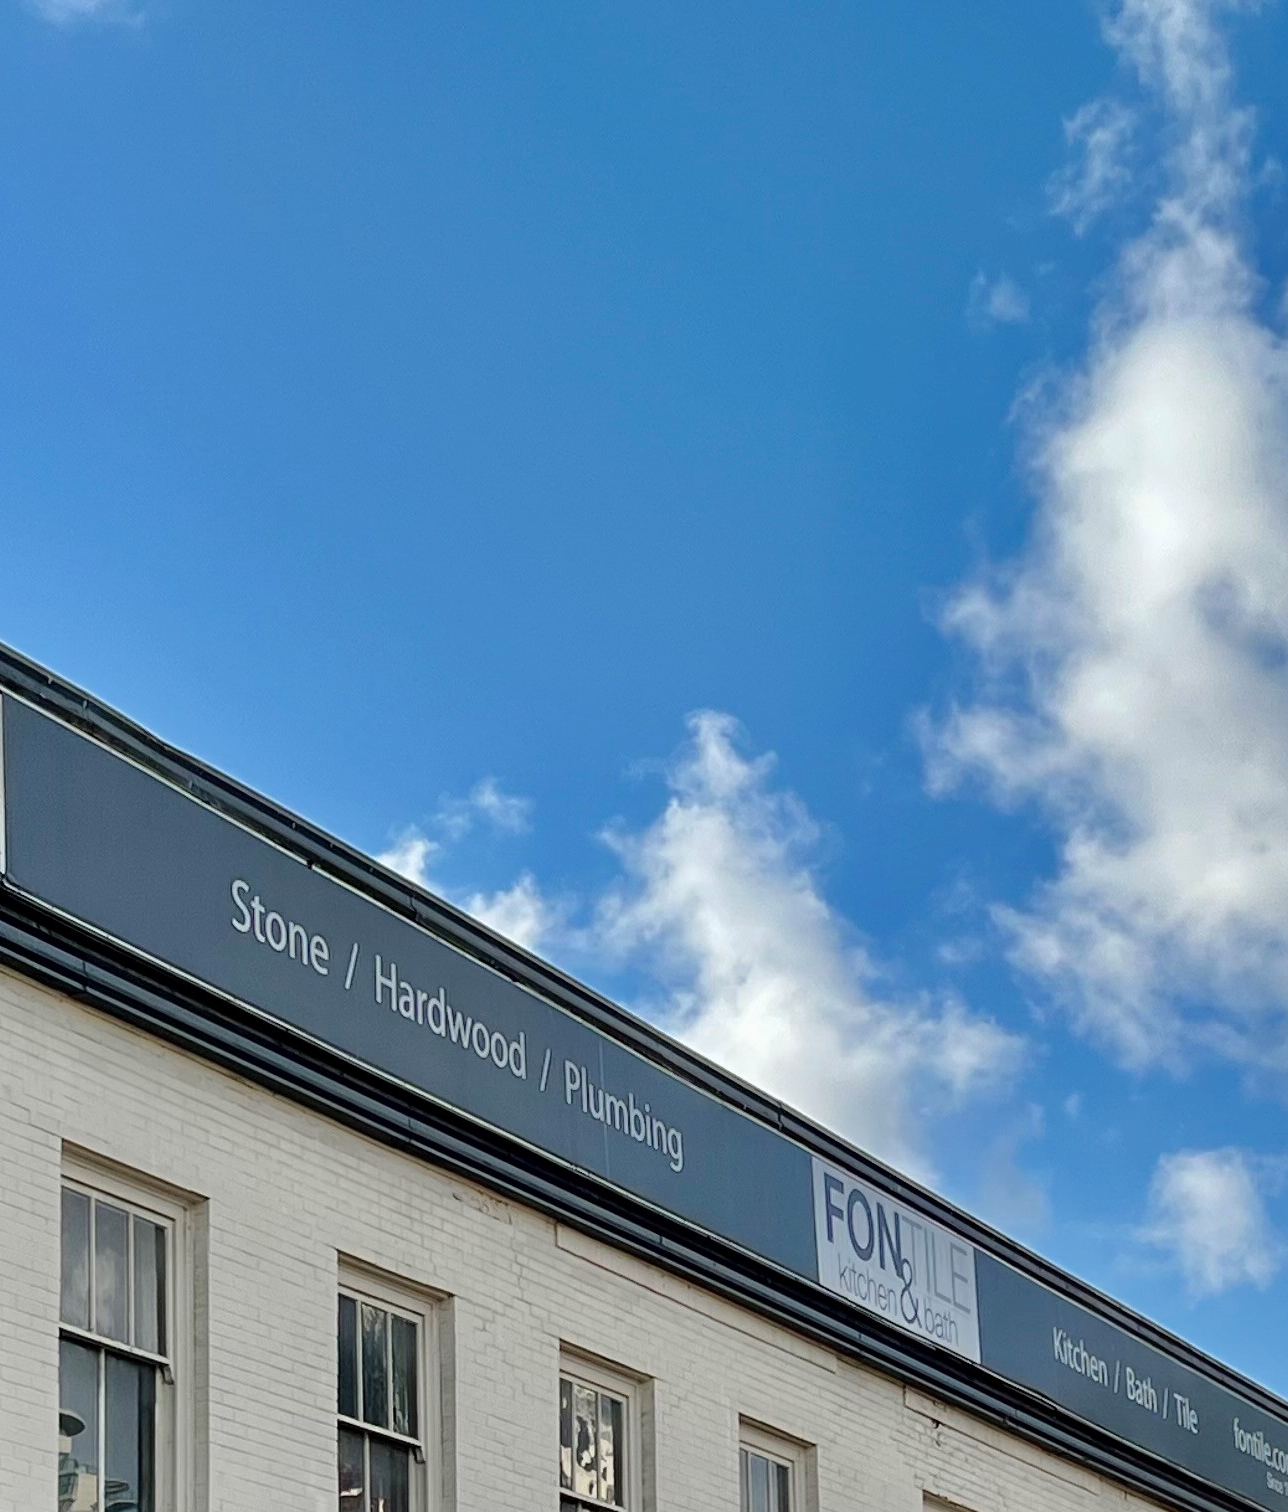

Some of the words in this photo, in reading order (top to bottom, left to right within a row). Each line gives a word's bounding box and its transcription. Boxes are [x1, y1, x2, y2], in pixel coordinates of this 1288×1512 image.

[231, 879, 330, 976] Stone
[374, 953, 527, 1079] Hardwood
[564, 1059, 685, 1173] Plumbing
[823, 1171, 971, 1315] FONTILE
[838, 1253, 898, 1317] kitchen
[924, 1298, 960, 1348] bath
[1052, 1326, 1109, 1387] Kitchen
[1125, 1366, 1159, 1414] Bath
[1173, 1392, 1200, 1435] Tile
